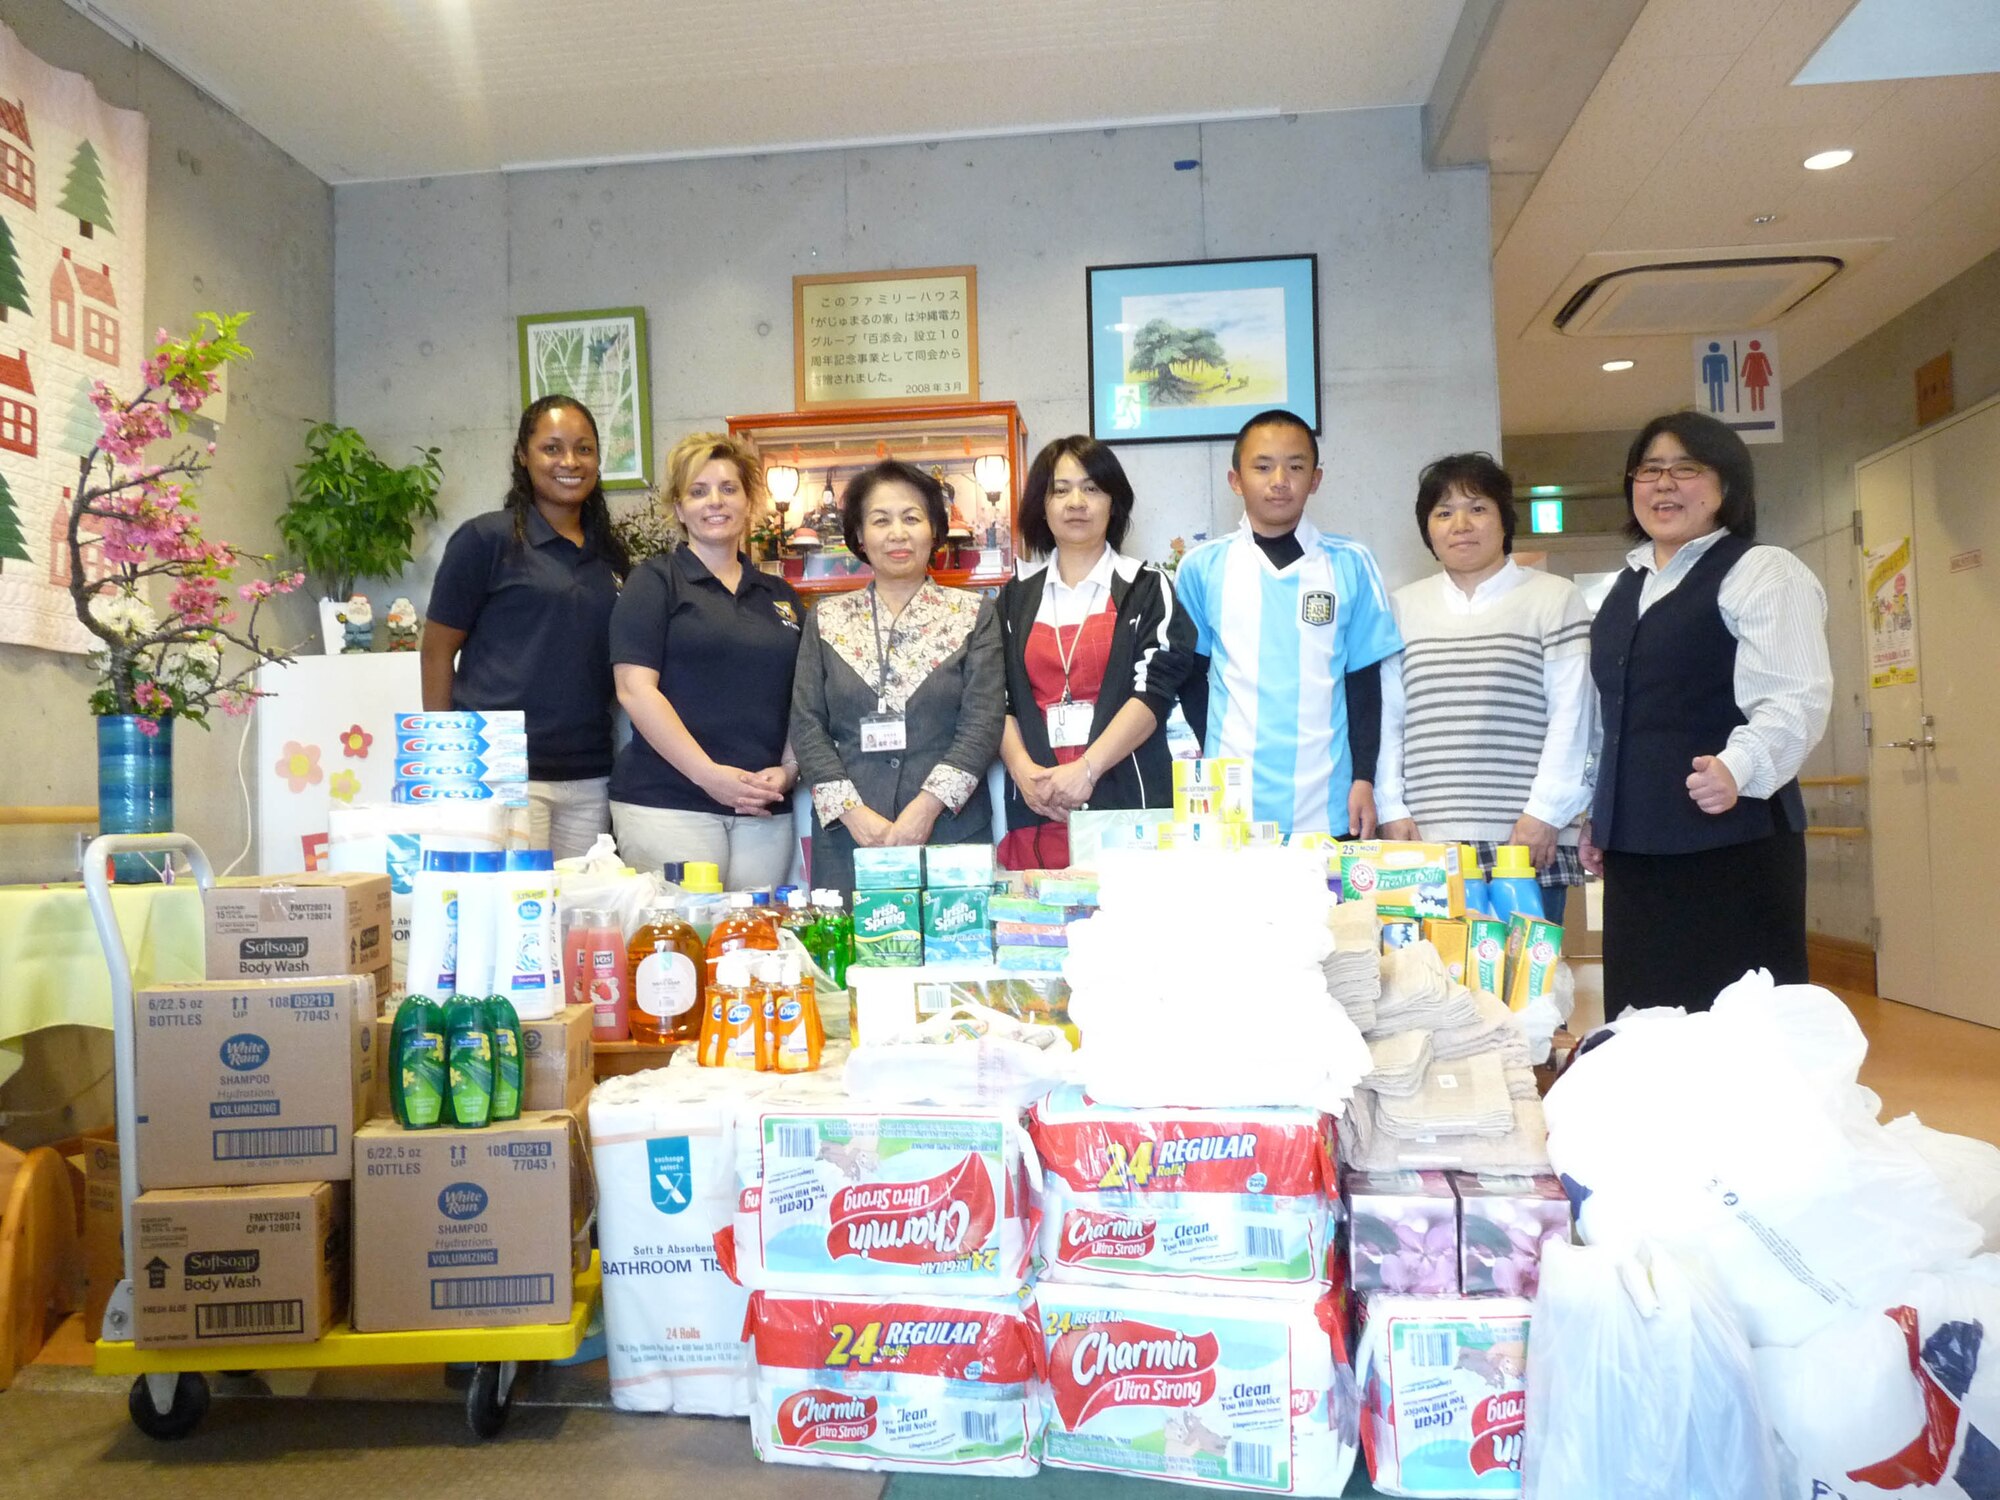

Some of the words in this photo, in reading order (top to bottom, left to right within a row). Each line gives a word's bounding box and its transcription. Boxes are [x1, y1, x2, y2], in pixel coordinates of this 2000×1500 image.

[821, 290, 960, 308] このファミリーハウス
[810, 348, 961, 367] 周年記念事業として同会から
[402, 716, 476, 730] Crest
[404, 738, 479, 751] Crest
[402, 762, 477, 775] Crest
[411, 785, 483, 799] Crest
[872, 904, 899, 919] Irish
[943, 903, 969, 919] Irish
[864, 911, 905, 932] Spring
[935, 909, 976, 931] Spring
[245, 939, 306, 954] Softsoap
[239, 961, 272, 975] Body
[274, 960, 309, 973] Wash
[149, 999, 186, 1011] 6/22.5
[191, 1000, 203, 1010] oz
[269, 997, 290, 1009] 108
[293, 994, 331, 1007] 09219
[149, 1014, 202, 1027] BOTTLES
[233, 1011, 248, 1019] UP
[294, 1010, 330, 1022] 77043
[227, 1042, 265, 1055] White
[228, 1052, 260, 1066] Rain
[219, 1074, 270, 1085] SHAMPOO
[217, 1088, 275, 1100] Hydrations
[213, 1103, 277, 1116] VOLUMIZING
[367, 1147, 405, 1159] 6/22.5
[408, 1148, 421, 1158] oz
[487, 1145, 508, 1157] 108
[512, 1144, 549, 1156] 09219
[451, 1160, 466, 1168] UP
[512, 1159, 548, 1171] 77043
[654, 1155, 684, 1164] exchange
[1098, 1141, 1154, 1189] 24
[1158, 1134, 1257, 1165] REGULAR
[367, 1163, 421, 1176] BOTTLES
[659, 1164, 680, 1172] select
[445, 1190, 482, 1203] White
[768, 1191, 793, 1205] Notice
[844, 1187, 892, 1211] Strong
[892, 1184, 929, 1204] Ultra
[448, 1201, 479, 1216] Rain
[779, 1199, 814, 1215] Clean
[438, 1224, 488, 1234] SHAMPOO
[848, 1200, 970, 1259] Charmin
[1068, 1219, 1145, 1247] Charmin
[1174, 1222, 1210, 1240] Clean
[435, 1237, 493, 1249] Hydrations
[1179, 1238, 1193, 1247] Will
[1195, 1234, 1218, 1243] Notice
[633, 1245, 653, 1255] Soft
[657, 1244, 663, 1254] &
[1091, 1242, 1114, 1255] Ultra
[1115, 1241, 1147, 1256] Strong
[191, 1253, 256, 1272] Softsoap
[431, 1252, 495, 1265] VOLUMIZING
[971, 1248, 999, 1271] 24
[602, 1259, 692, 1275] BATHROOM
[920, 1259, 968, 1275] REGULAR
[184, 1277, 220, 1292] Body
[222, 1275, 261, 1290] Wash
[1045, 1312, 1072, 1335] 24
[1073, 1310, 1124, 1325] REGULAR
[666, 1328, 677, 1340] 24
[680, 1327, 701, 1340] Rolls
[825, 1322, 883, 1367] 24
[884, 1322, 982, 1345] REGULAR
[1071, 1329, 1198, 1386] Charmin
[1114, 1380, 1150, 1402] Ultra
[1151, 1379, 1202, 1403] Strong
[1233, 1383, 1271, 1399] Clean
[793, 1394, 867, 1428] Charmin
[1221, 1403, 1236, 1411] You
[1238, 1399, 1253, 1409] Will
[1256, 1396, 1281, 1406] Notice
[1486, 1398, 1525, 1423] rong
[884, 1426, 896, 1435] You
[898, 1423, 912, 1433] Will
[913, 1420, 937, 1430] Notice
[1414, 1410, 1454, 1430] Clean
[815, 1424, 837, 1440] Ultra
[838, 1424, 868, 1439] Strong
